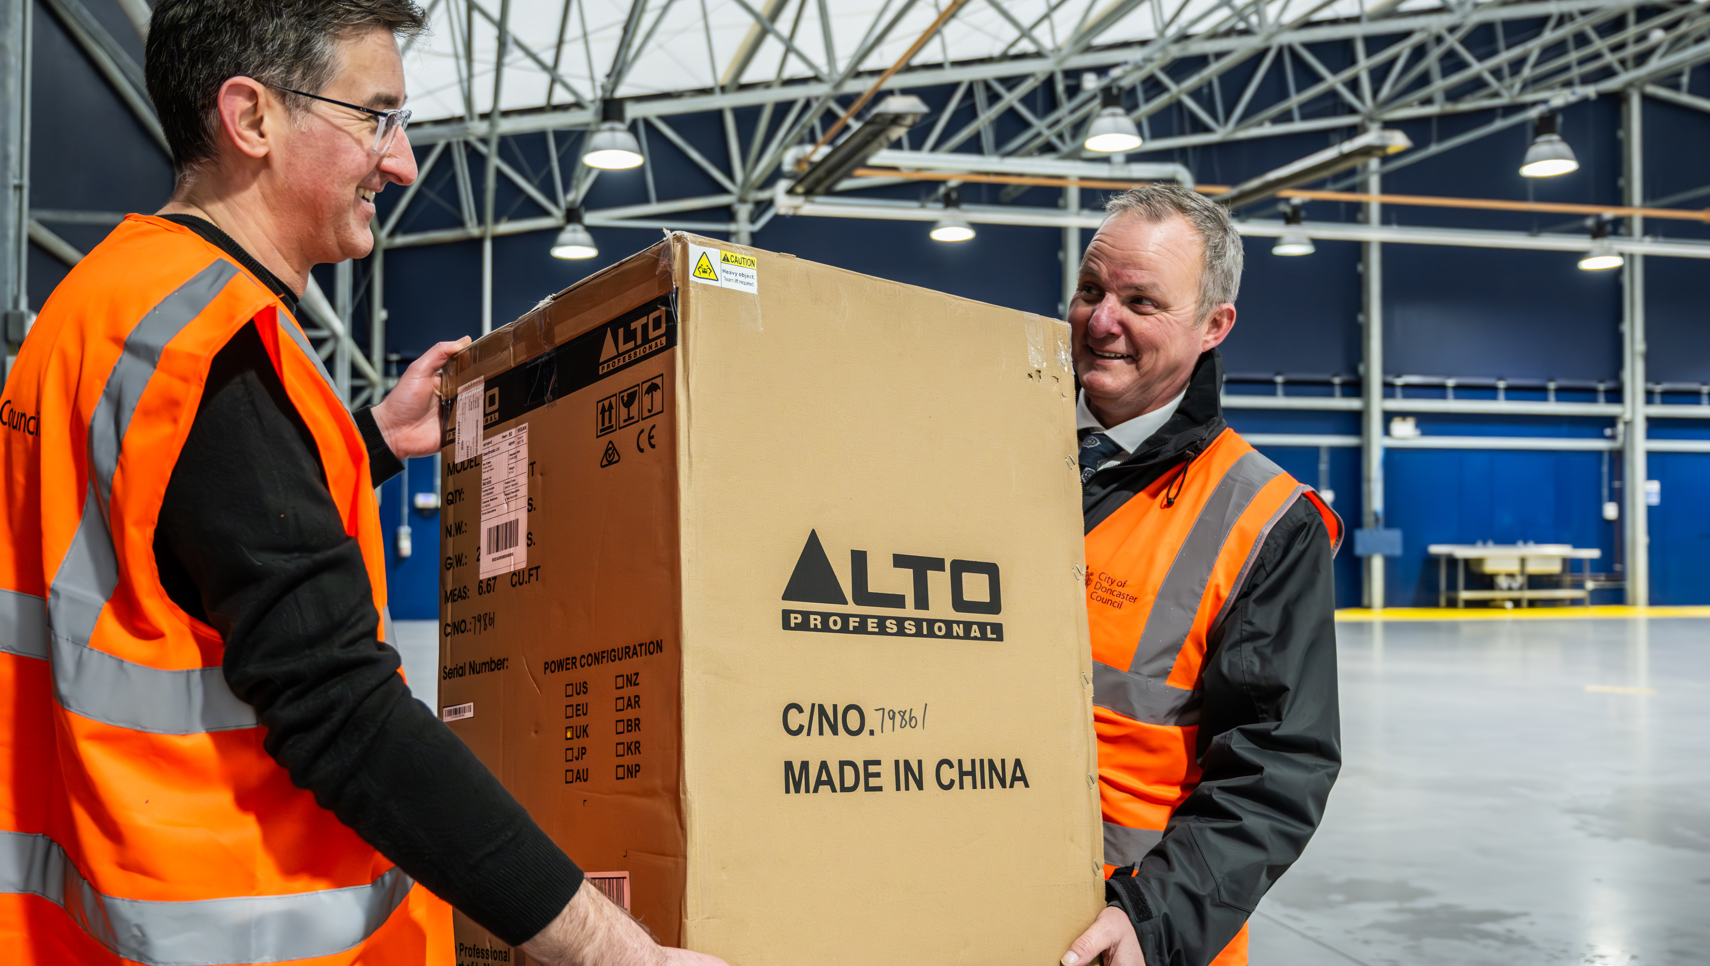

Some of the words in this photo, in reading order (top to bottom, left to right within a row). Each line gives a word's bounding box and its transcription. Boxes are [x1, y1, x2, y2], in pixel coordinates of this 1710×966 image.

[730, 255, 755, 268] CAUTION
[722, 269, 738, 277] Heavy
[599, 308, 666, 363] ALTO
[601, 340, 665, 373] PROFESSIONAL
[0, 399, 41, 438] Counci
[446, 488, 465, 506] QTY:
[445, 520, 467, 539] N.W.:
[445, 552, 467, 571] G.W.:
[781, 528, 1002, 615] ALTO
[1098, 571, 1116, 587] City
[1116, 580, 1128, 588] of
[444, 585, 470, 605] MEAS:
[477, 576, 497, 596] 6.67
[510, 565, 541, 588] CU.FT
[1093, 581, 1138, 604] Doncaster
[1090, 591, 1124, 610] Council
[789, 613, 998, 639] PROFESSIONAL
[543, 656, 578, 675] POWER
[579, 639, 663, 668] CONFIGURATION
[443, 662, 466, 681] Serial
[468, 657, 509, 676] Number:
[575, 681, 588, 696] US
[626, 672, 640, 688] NZ
[575, 702, 588, 718] EU
[626, 695, 641, 711] AR
[626, 717, 641, 733] BR
[782, 702, 875, 737] C/NO.
[575, 724, 589, 740] UK
[575, 747, 587, 761] JP
[626, 740, 641, 756] KR
[575, 768, 589, 783] AU
[626, 764, 641, 779] NP
[783, 759, 883, 795] MADE
[894, 758, 924, 792] IN
[935, 757, 1030, 791] CHINA
[459, 943, 511, 962] Professional
